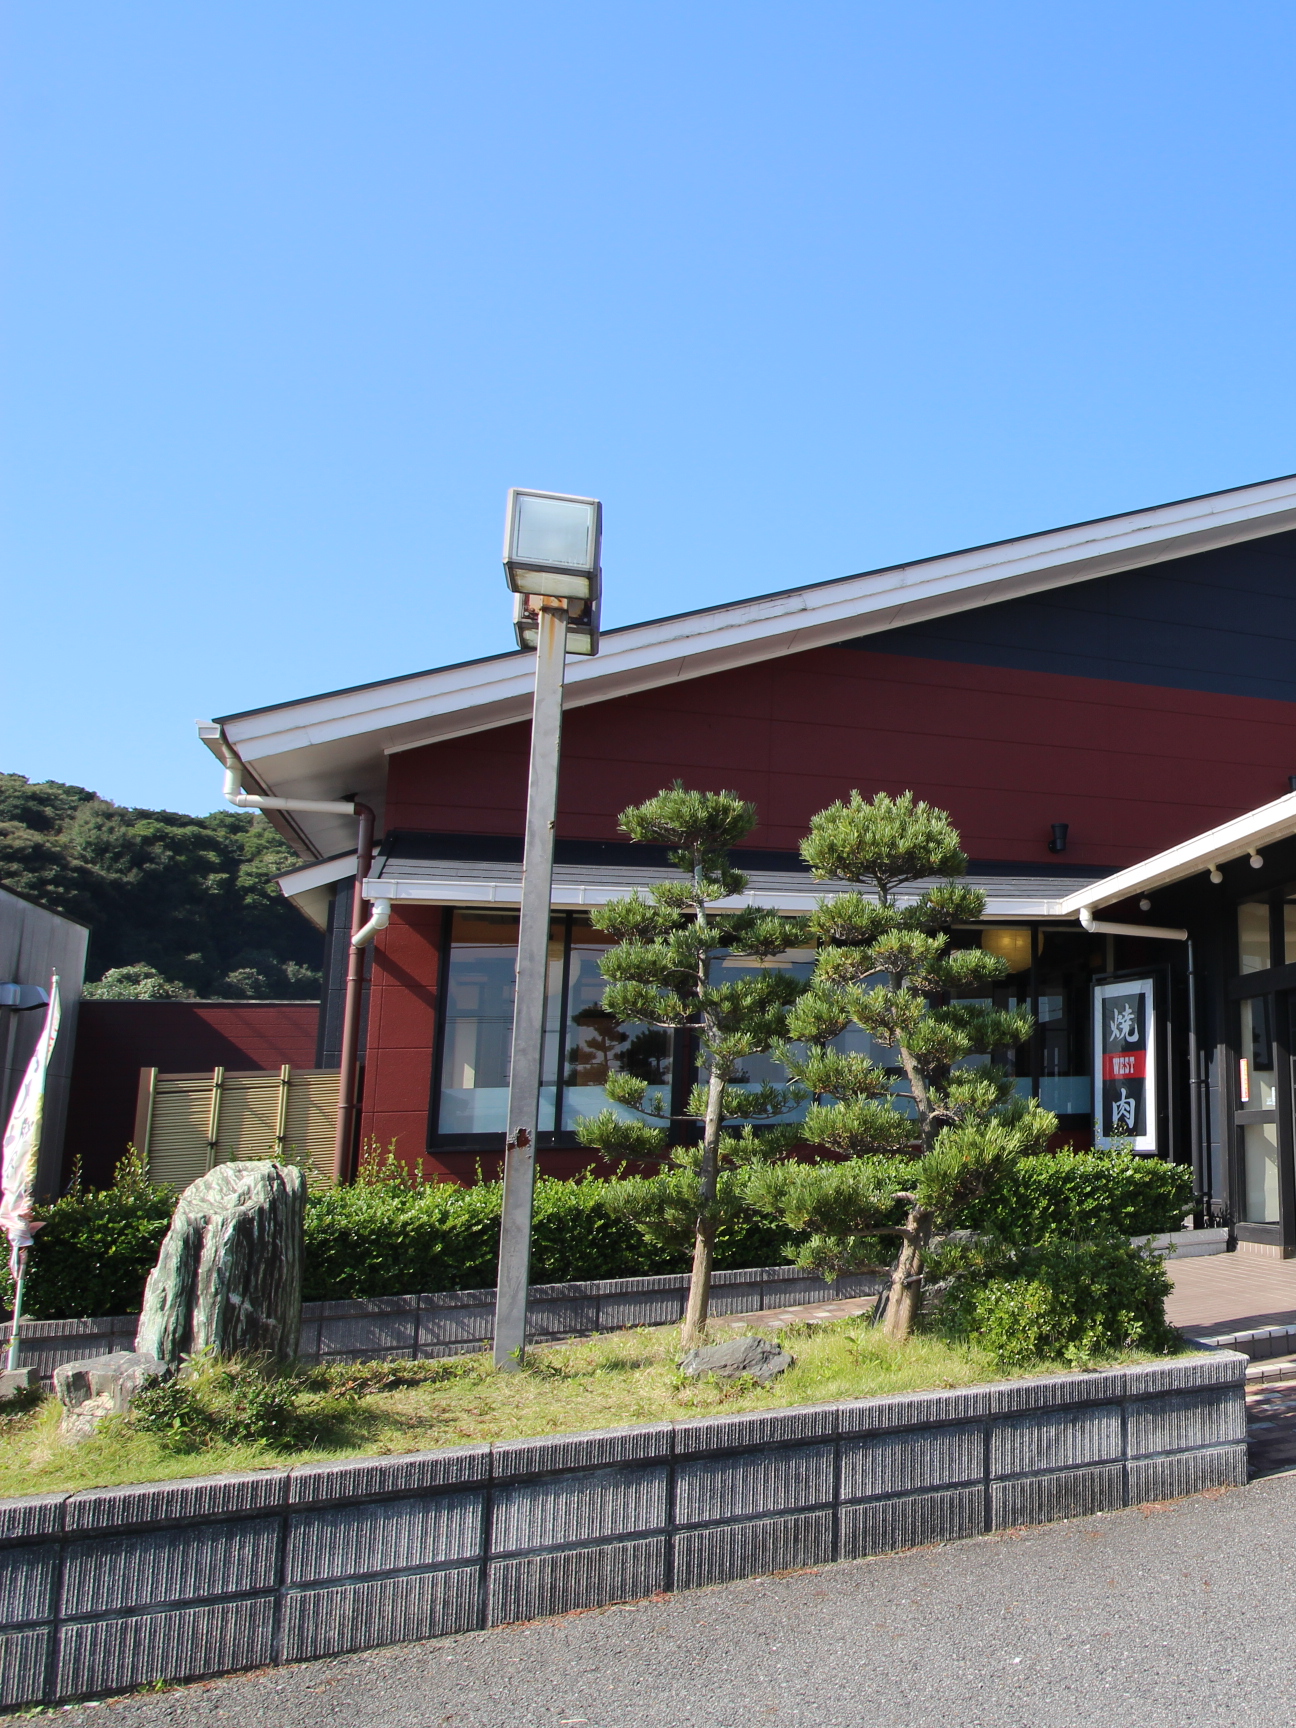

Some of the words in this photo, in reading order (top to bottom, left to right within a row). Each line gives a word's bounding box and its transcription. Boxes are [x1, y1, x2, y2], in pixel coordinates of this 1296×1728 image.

[1109, 1003, 1139, 1043] 焼
[1112, 1056, 1135, 1075] WEST
[1112, 1088, 1136, 1129] 肉
